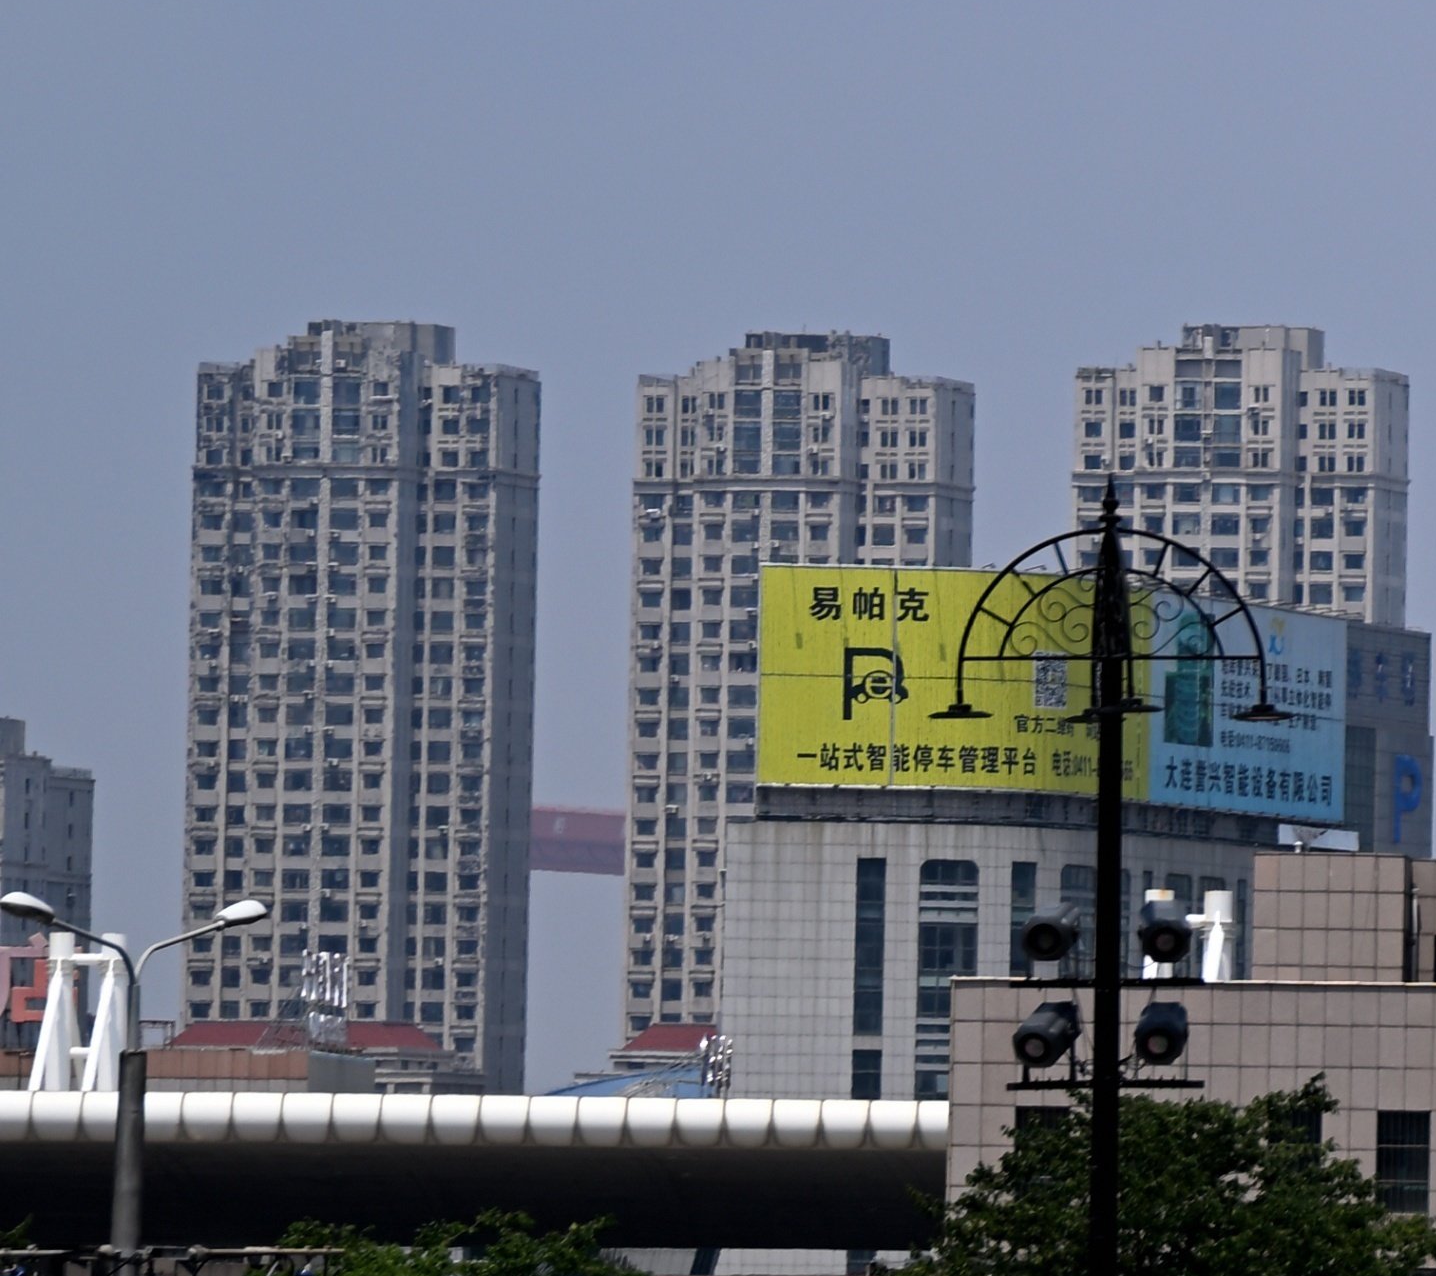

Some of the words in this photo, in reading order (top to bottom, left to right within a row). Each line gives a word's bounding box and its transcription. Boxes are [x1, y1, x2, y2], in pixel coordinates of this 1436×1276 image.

[809, 586, 929, 622] 易帕克
[797, 742, 1037, 776] 一站式智能停车管理平台
